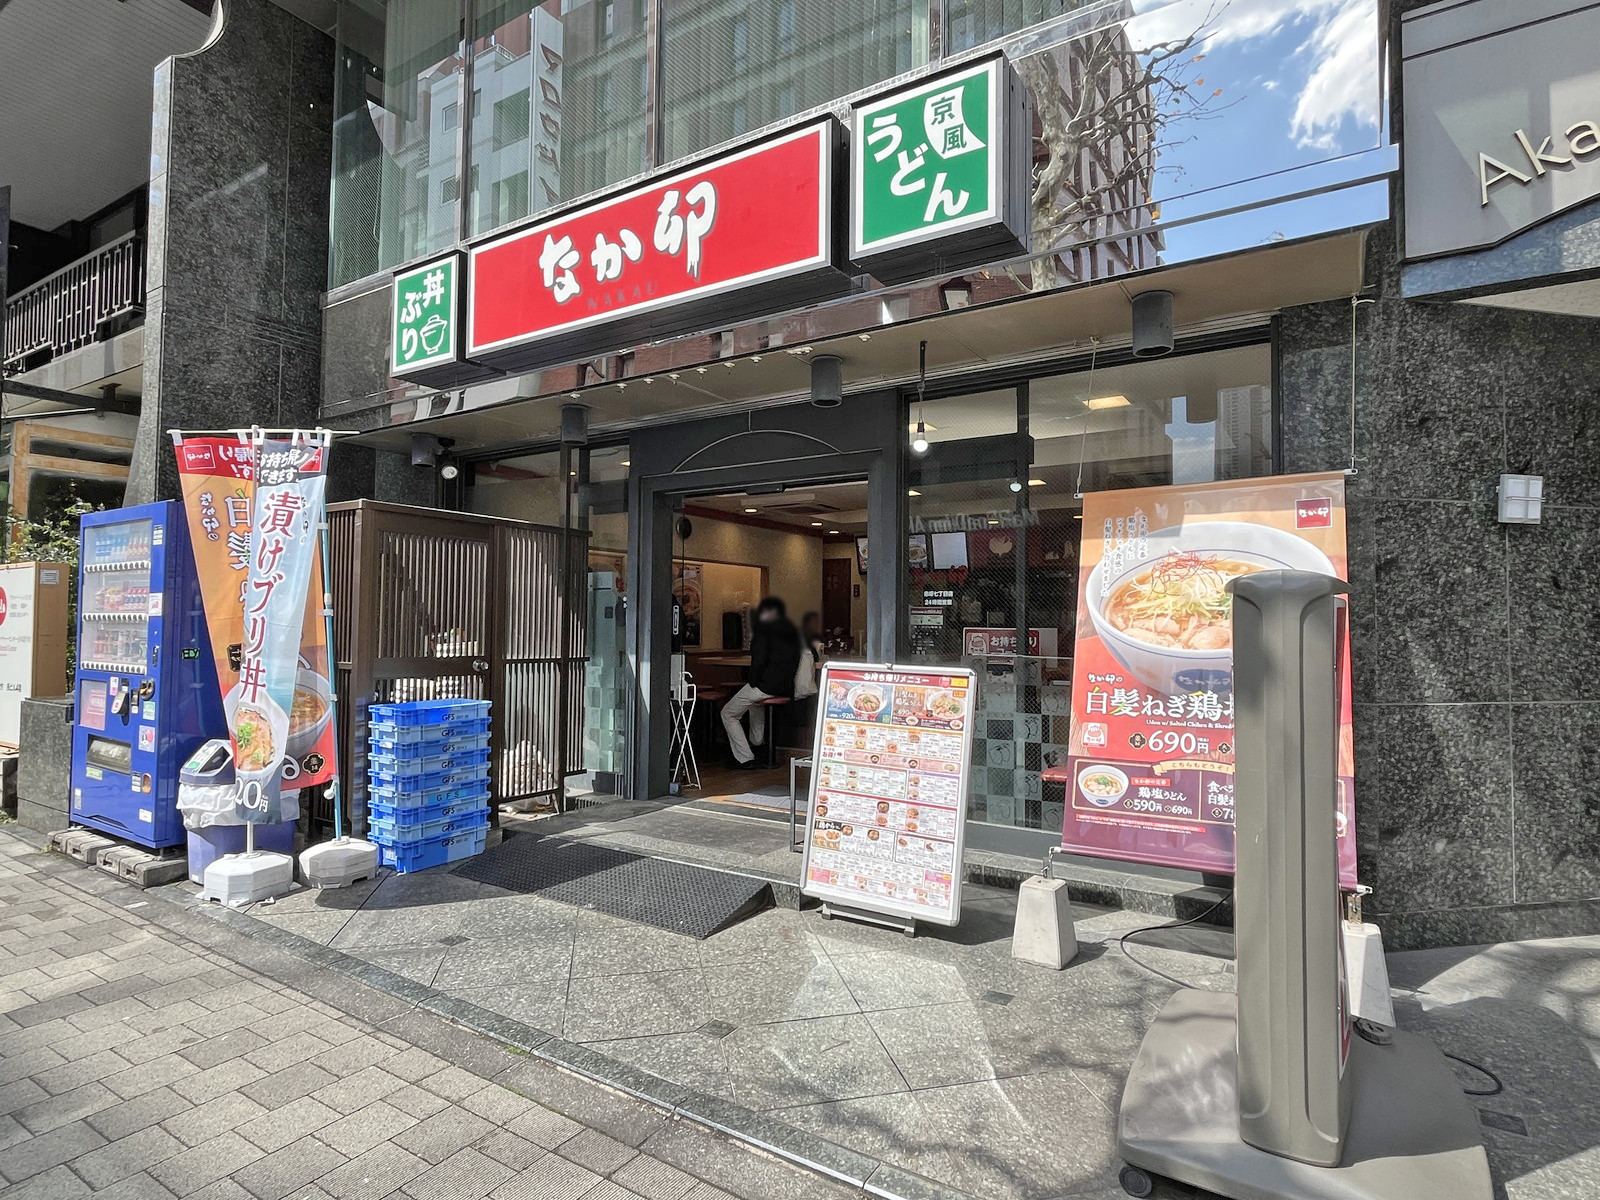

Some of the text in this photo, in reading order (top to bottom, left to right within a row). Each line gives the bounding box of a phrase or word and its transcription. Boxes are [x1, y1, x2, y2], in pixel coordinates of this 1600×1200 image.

[930, 94, 968, 157] 京風
[867, 114, 969, 223] うどん
[539, 180, 717, 305] なか卯
[587, 281, 657, 311] NAKAU
[400, 269, 445, 360] 丼ぶり
[1298, 507, 1329, 518] なか卯
[239, 491, 301, 704] 漬けブリ丼
[863, 672, 930, 684] お持ち帰りメニュー
[1088, 673, 1123, 684] なか卯の
[442, 713, 455, 721] GFS
[441, 729, 455, 737] GFS
[1148, 730, 1209, 754] 690円
[442, 744, 455, 752] GFS
[441, 760, 454, 768] GFS
[442, 776, 455, 784] GFS
[436, 791, 459, 801] GFS
[1138, 786, 1187, 801] 鶏塩うどん
[442, 807, 455, 816] GFS
[1133, 799, 1193, 815] 590円 690円
[442, 823, 455, 832] GFS
[442, 838, 455, 847] GFS
